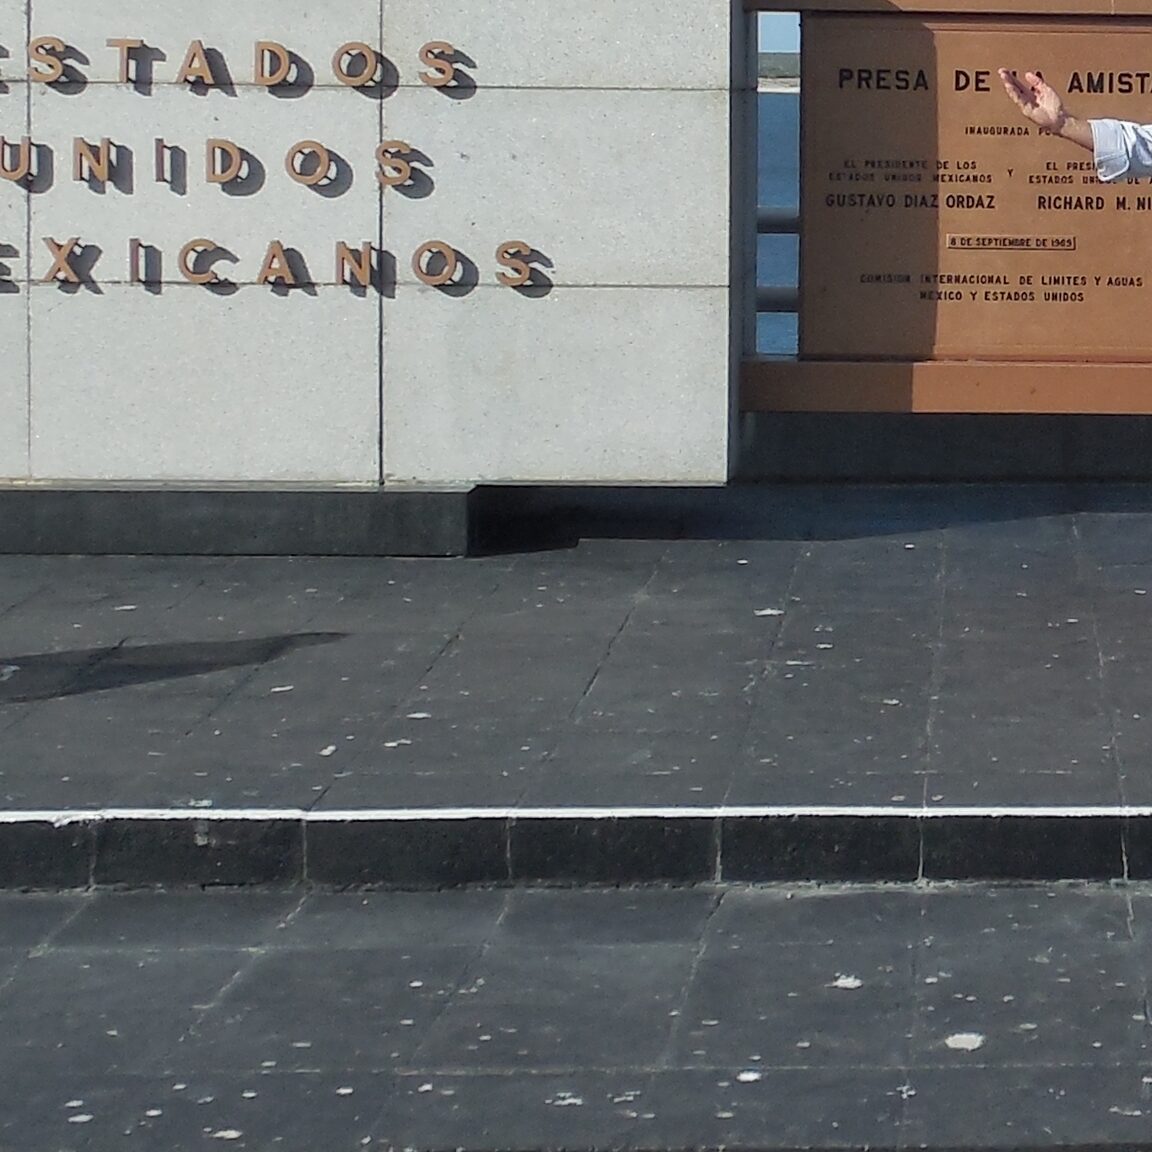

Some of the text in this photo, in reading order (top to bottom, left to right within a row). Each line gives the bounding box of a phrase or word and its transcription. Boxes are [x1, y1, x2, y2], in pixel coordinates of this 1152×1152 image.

[0, 36, 456, 87] STADOS
[839, 68, 929, 91] PRESA
[954, 70, 991, 92] DE
[965, 126, 1030, 136] INAUGURADA
[0, 135, 413, 187] UNIDOS
[936, 161, 950, 170] DE
[956, 161, 977, 170] LOS
[1046, 162, 1058, 171] EL
[1007, 168, 1014, 177] Y
[933, 174, 993, 184] MEXICANOS
[1029, 175, 1074, 184] ESTADOS
[826, 194, 996, 209] GUSTAVO DIAZ ORDAZ
[1037, 196, 1105, 210] RICHARD
[1116, 197, 1131, 210] M.
[950, 237, 957, 247] 8
[960, 237, 973, 247] DE
[975, 237, 1031, 247] SEPTIEMBRE
[1035, 238, 1048, 248] DE
[0, 236, 533, 287] XICANOS
[920, 275, 1010, 286] INTERNACIONAL
[1019, 276, 1033, 286] DE
[1041, 276, 1087, 286] LIMITES
[1094, 276, 1102, 286] Y
[1107, 277, 1144, 287] AGUAS
[920, 291, 1085, 302] MEXICO Y ESTADOS UNIDOS
